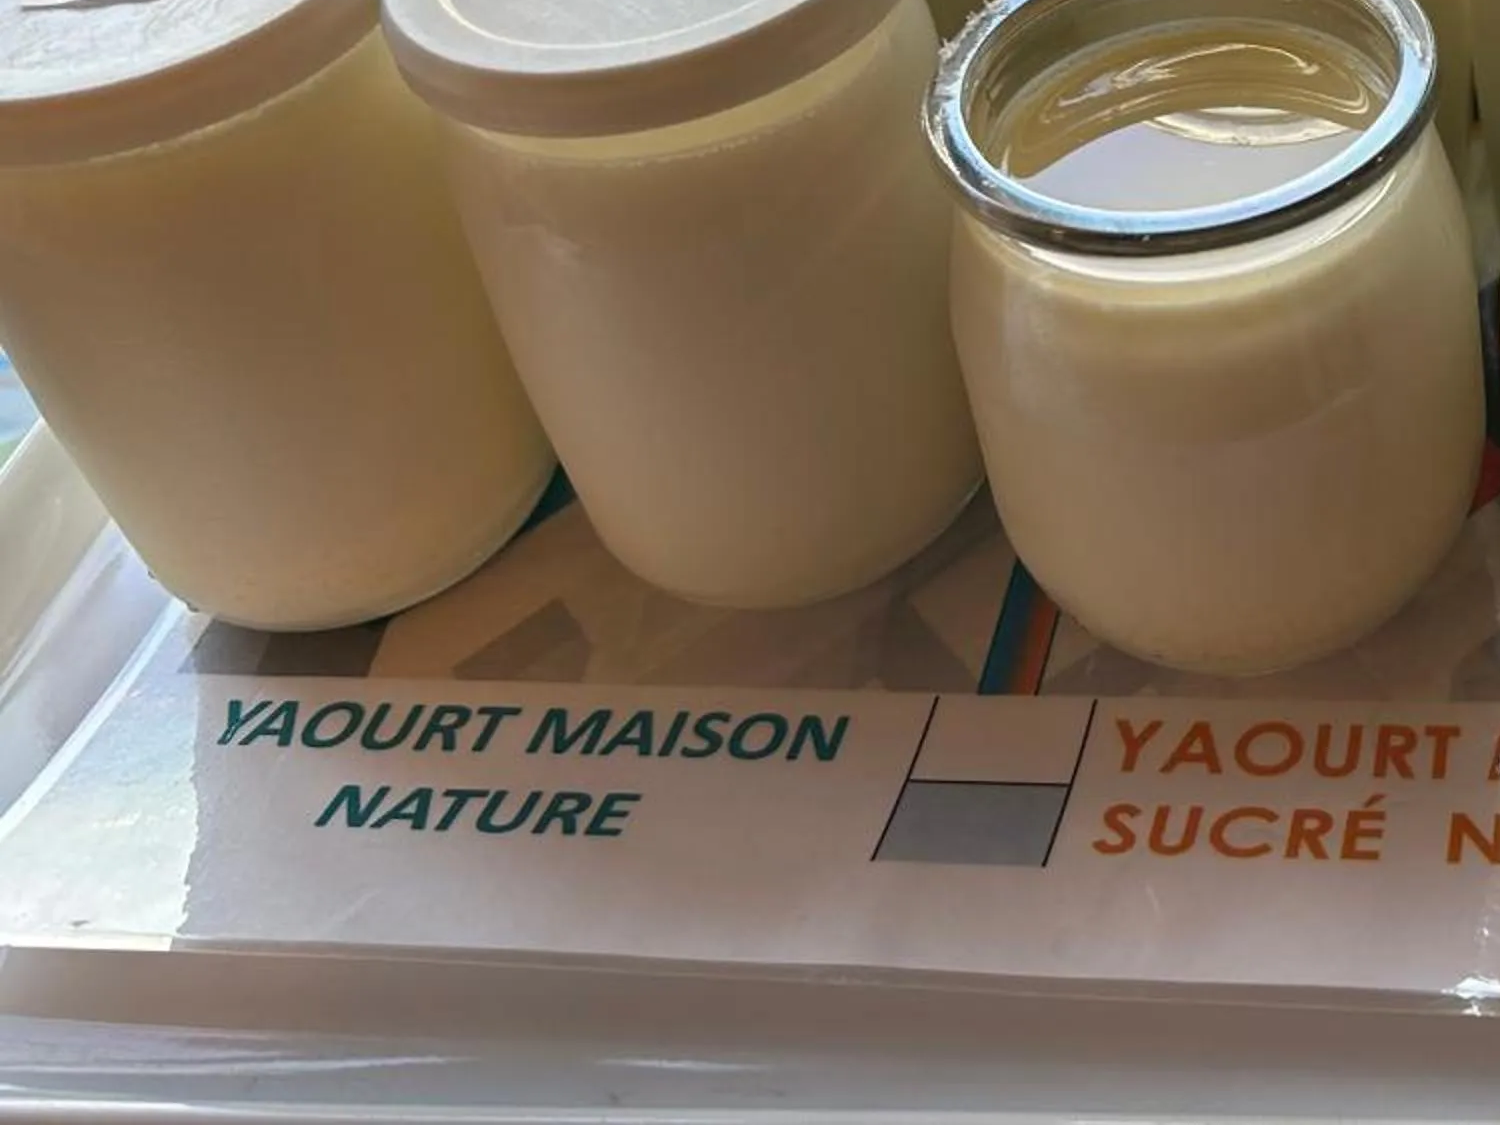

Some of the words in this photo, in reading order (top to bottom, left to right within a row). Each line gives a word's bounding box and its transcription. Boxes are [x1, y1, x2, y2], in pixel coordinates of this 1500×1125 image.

[217, 698, 521, 754] YAOURT
[526, 707, 852, 762] MAISON
[1114, 718, 1461, 781] YAOURT
[314, 783, 642, 838] NATURE
[1091, 793, 1387, 862] SUCRÉ
